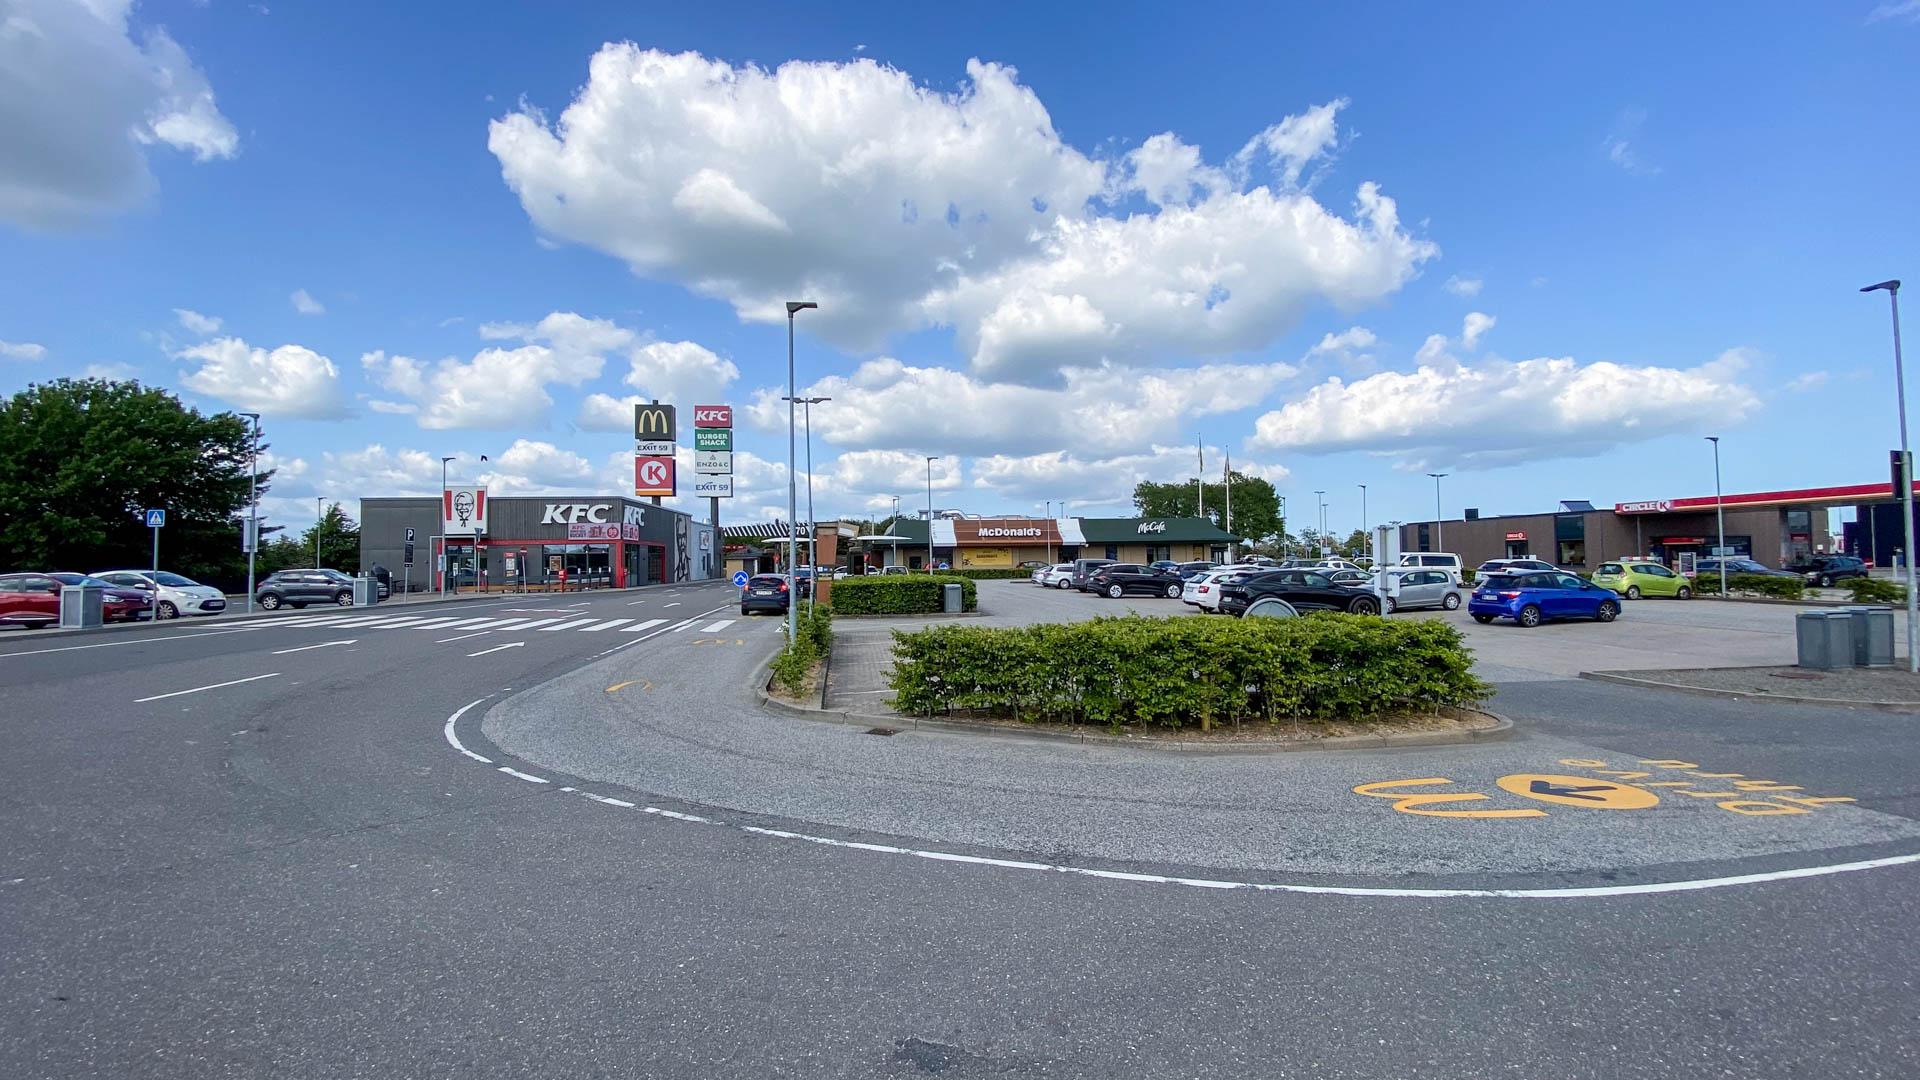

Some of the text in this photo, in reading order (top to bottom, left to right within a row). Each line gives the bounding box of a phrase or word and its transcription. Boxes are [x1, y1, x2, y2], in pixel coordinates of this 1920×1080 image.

[695, 410, 729, 422] KFC
[1622, 502, 1657, 512] CIRCLE
[541, 504, 612, 524] KFC
[623, 505, 645, 527] KFC
[407, 529, 414, 541] P
[978, 527, 1041, 537] McDonald's
